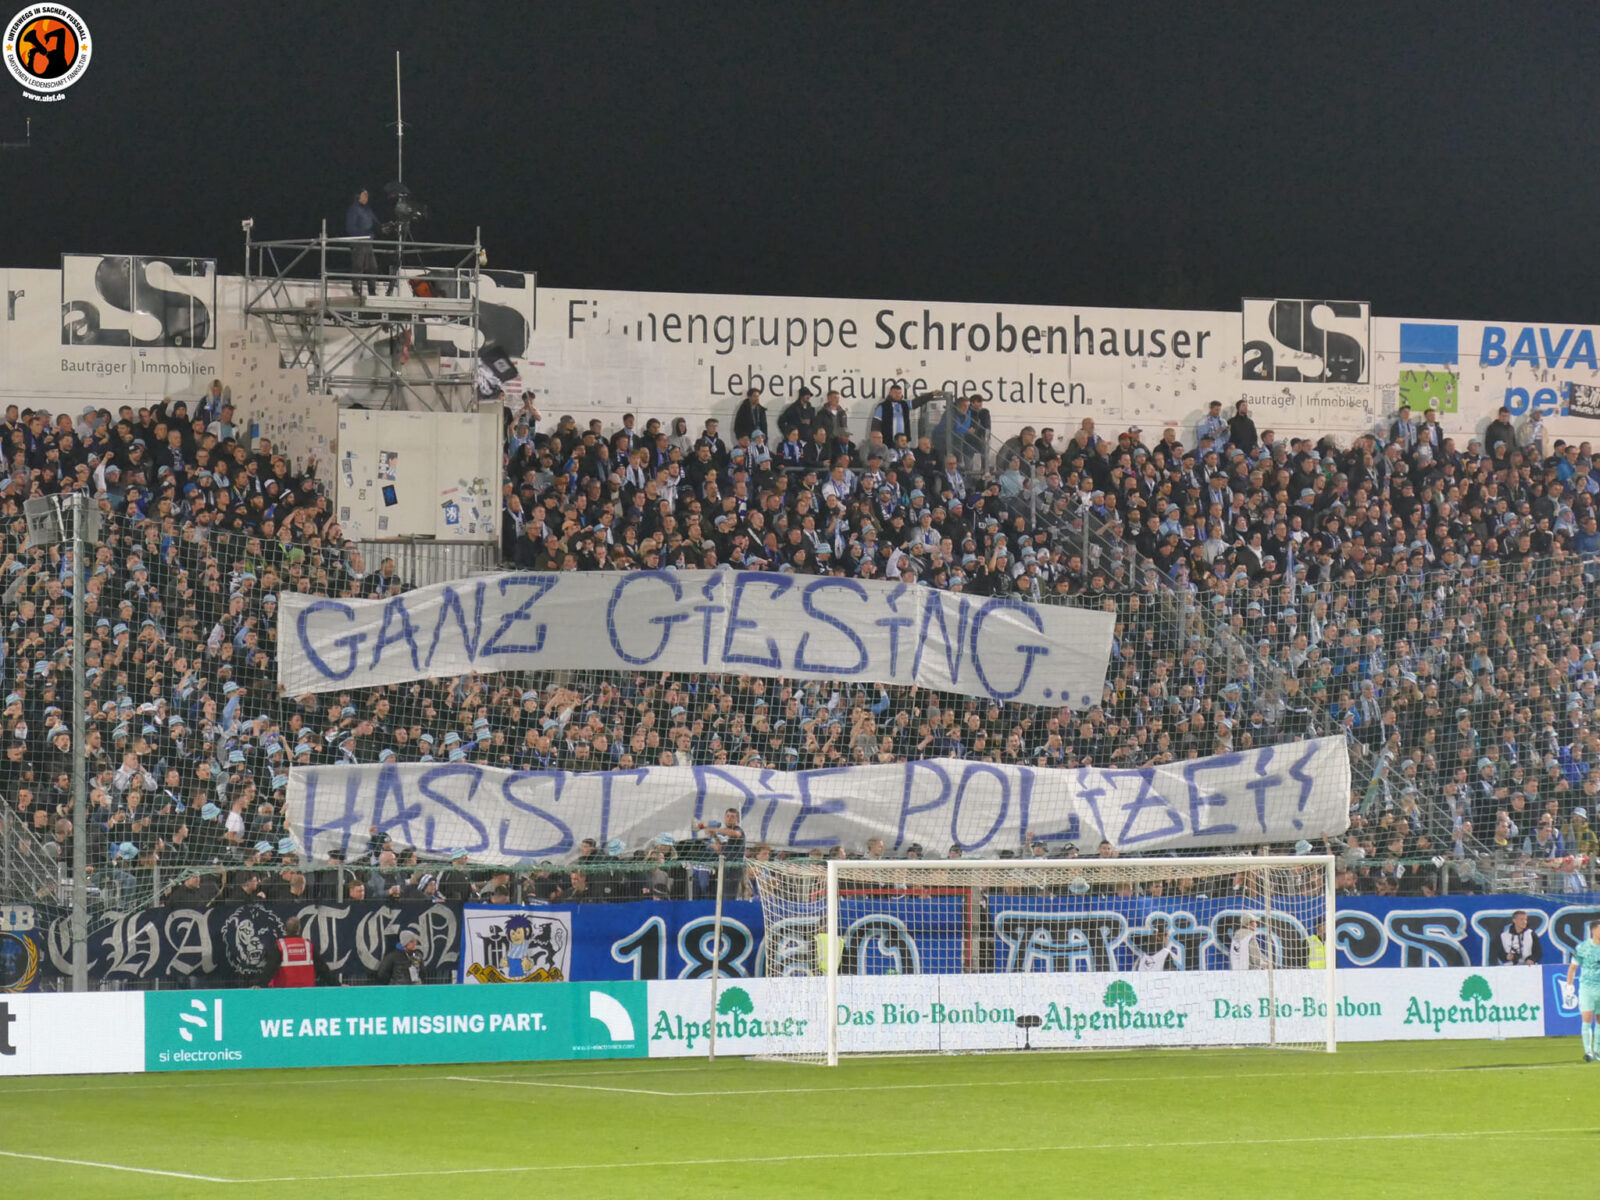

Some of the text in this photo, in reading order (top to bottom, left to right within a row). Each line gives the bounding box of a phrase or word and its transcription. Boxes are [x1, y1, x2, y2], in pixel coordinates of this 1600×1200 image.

[568, 299, 858, 356] Fengruppe
[874, 308, 1211, 359] Schrobenhauser
[61, 359, 216, 375] Bauträger Immobilien
[710, 364, 1086, 404] Lebensräume gestalten
[1242, 393, 1369, 409] Bauträger Immobilien
[297, 574, 559, 681] GANZ
[305, 763, 650, 863] HASST
[260, 1012, 547, 1038] WE ARE THE MISSING PART.
[836, 1001, 1015, 1026] Das Bio-Bonbon
[1041, 1001, 1188, 1040] Alpenbauer
[1214, 997, 1253, 1020] Das
[1403, 996, 1541, 1034] Alpenbauer
[651, 1010, 808, 1050] Alpenbauer
[159, 1047, 242, 1062] si electronics
